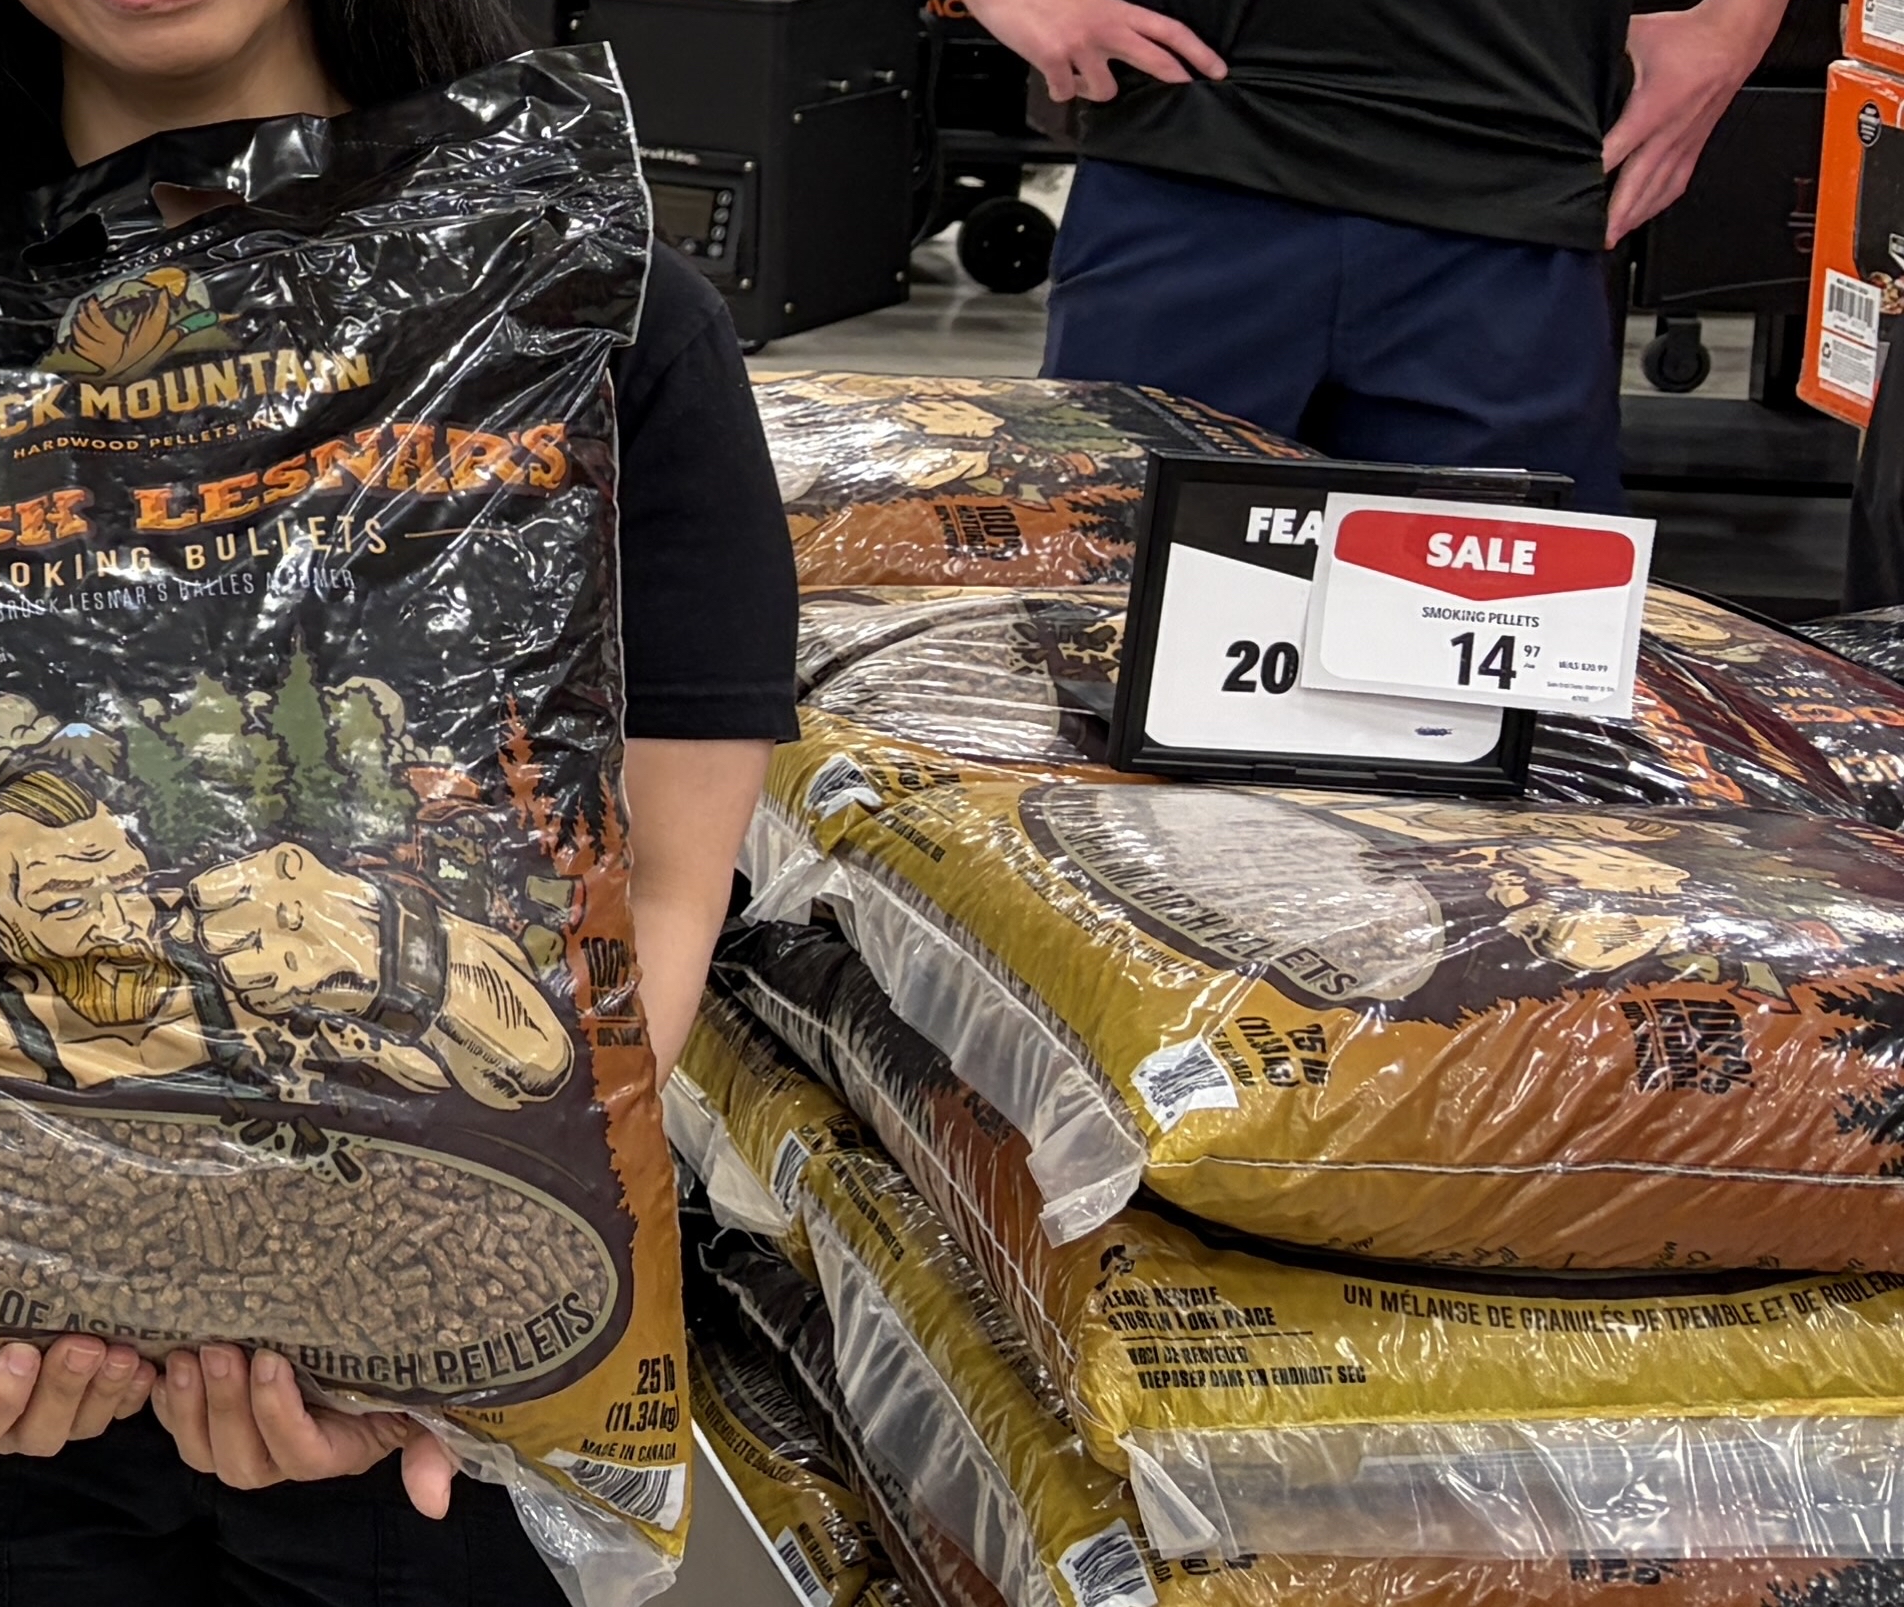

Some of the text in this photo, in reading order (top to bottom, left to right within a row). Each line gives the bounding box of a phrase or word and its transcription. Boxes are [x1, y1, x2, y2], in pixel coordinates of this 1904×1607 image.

[80, 349, 372, 421] MOUNTAIN
[13, 424, 237, 460] HARDWOOD PELLETS
[185, 515, 388, 571] BULLETS
[1425, 531, 1537, 577] SALE
[1421, 605, 1541, 629] SMOKING PELLETS
[1222, 640, 1300, 695] 20
[1450, 631, 1541, 691] 14 97
[1343, 1283, 1373, 1309] UN
[1488, 1302, 1514, 1330] DE
[1521, 1304, 1626, 1335] GRANULÉS
[1631, 1306, 1665, 1332] DE
[1667, 1298, 1762, 1333] TREMBLE
[1764, 1295, 1788, 1324] ET
[1794, 1288, 1821, 1319] DE
[299, 1291, 596, 1387] BIRCH PELLETS
[638, 1359, 662, 1395] 25
[1338, 1365, 1367, 1383] SEC
[580, 1439, 678, 1463] MADE IN CANADA
